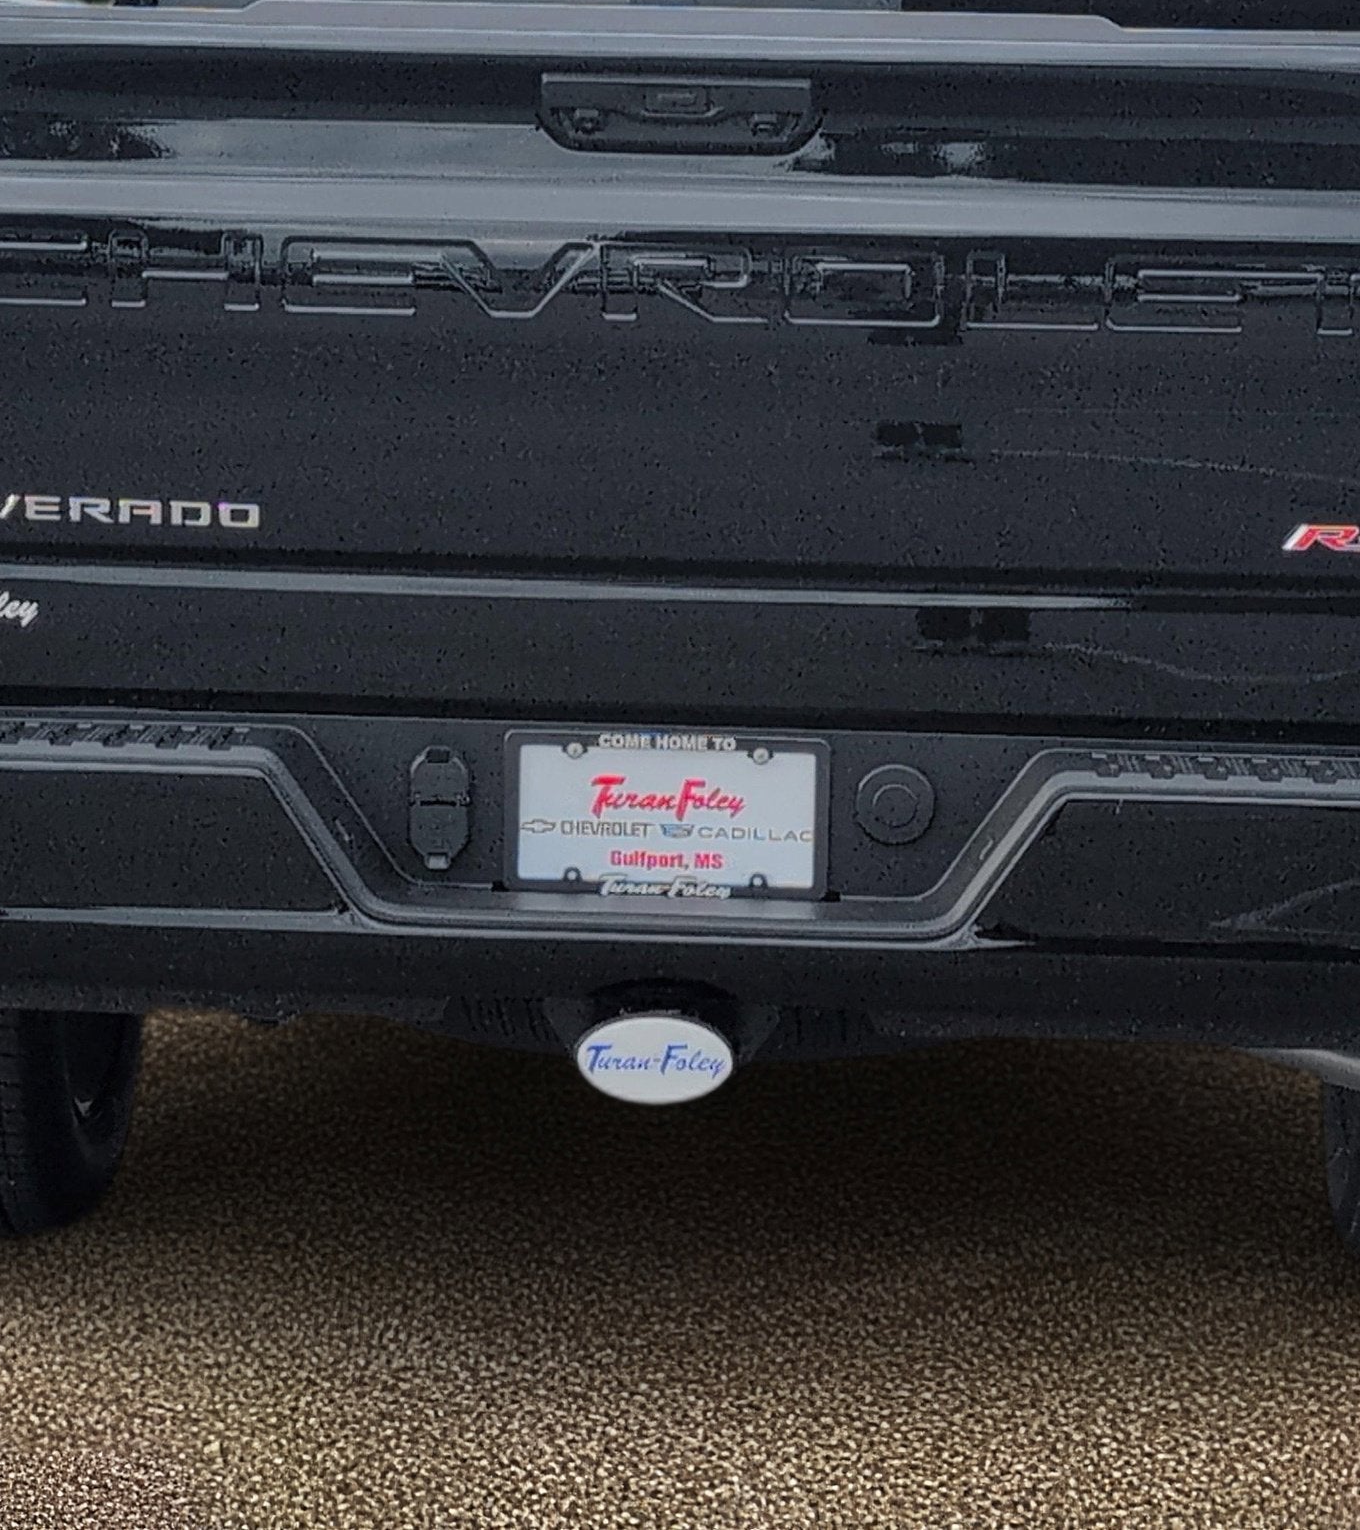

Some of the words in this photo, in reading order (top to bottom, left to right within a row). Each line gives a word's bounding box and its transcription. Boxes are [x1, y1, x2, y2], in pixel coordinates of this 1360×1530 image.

[598, 733, 653, 749] COME
[656, 734, 707, 751] HOME
[712, 737, 737, 752] TO
[560, 820, 653, 838] CHEVROLET
[697, 825, 815, 843] CADILLAC
[610, 850, 690, 870] Gulfport,
[694, 852, 724, 869] MS
